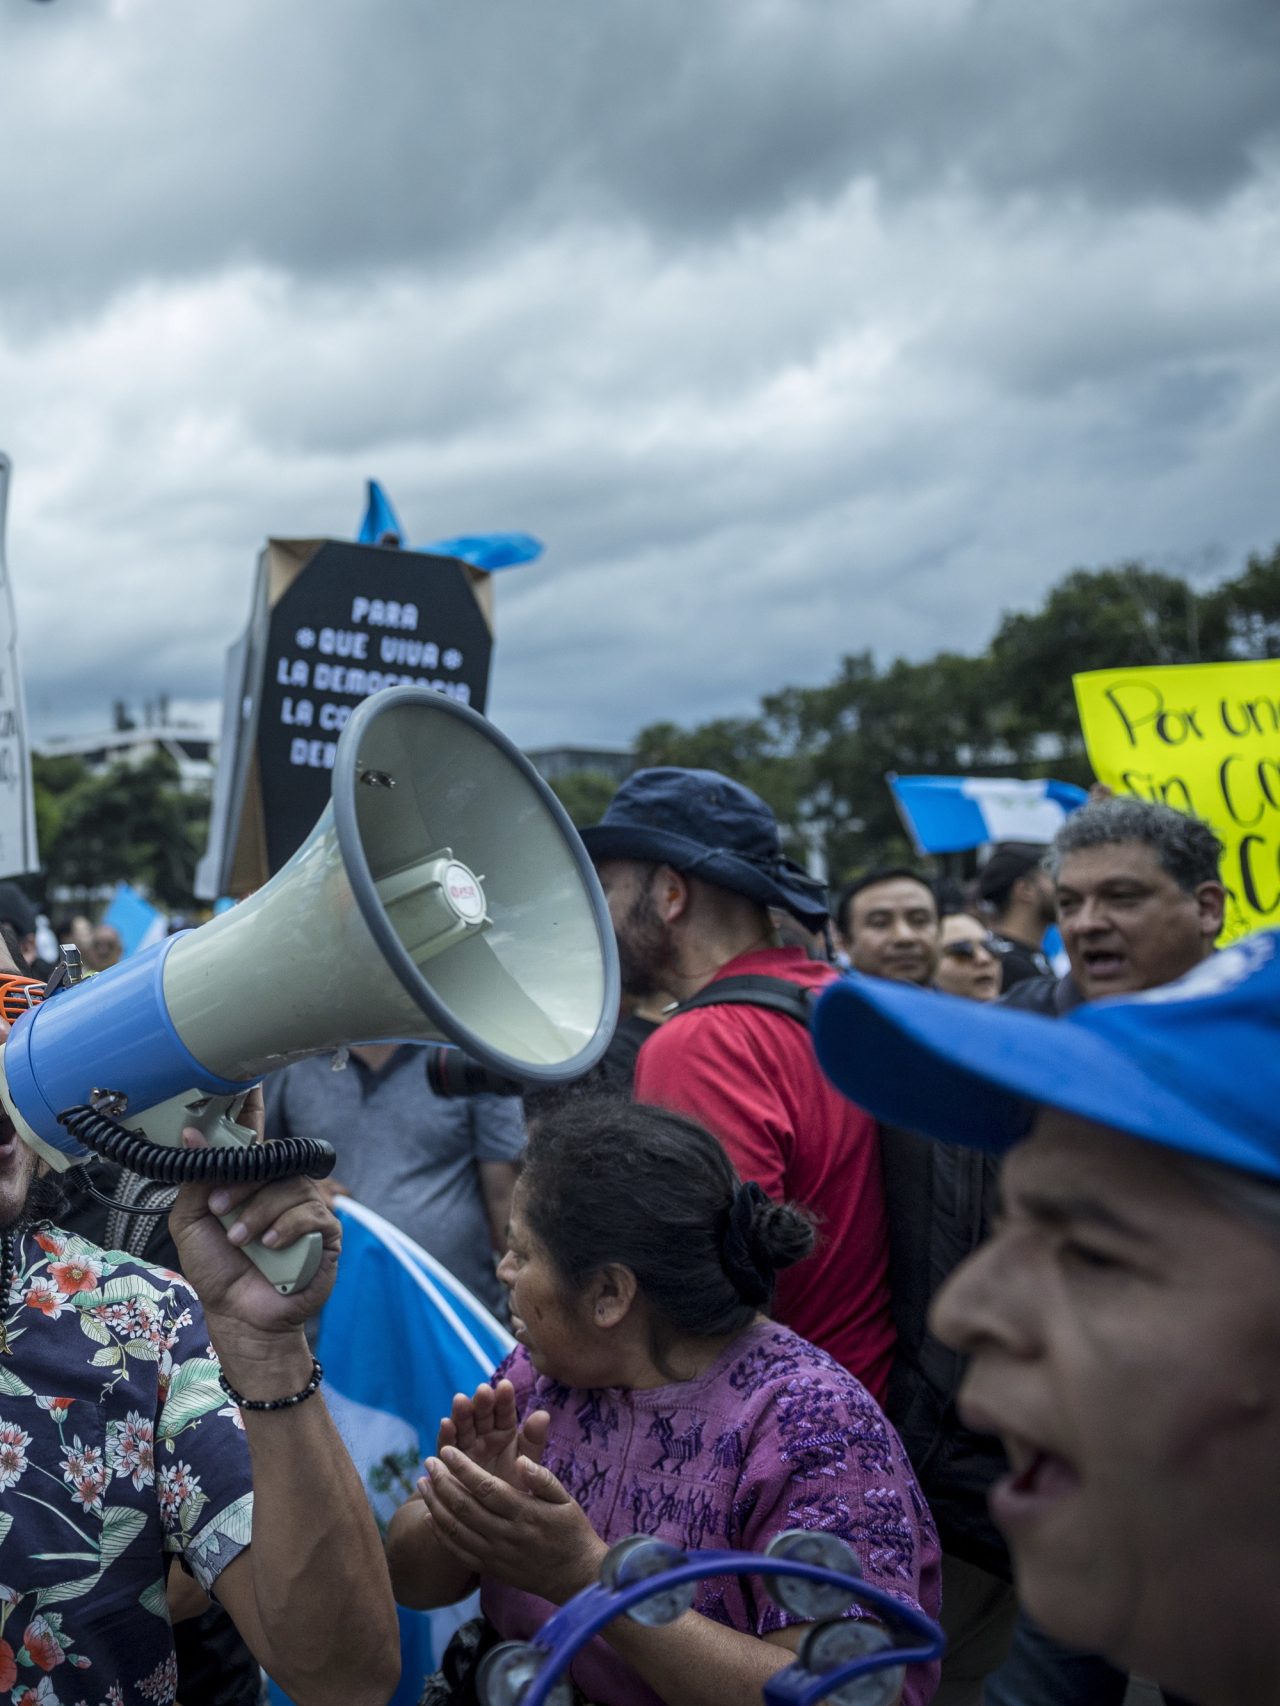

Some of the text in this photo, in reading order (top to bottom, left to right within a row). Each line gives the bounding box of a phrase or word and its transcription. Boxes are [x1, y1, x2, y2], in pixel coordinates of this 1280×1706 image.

[351, 596, 419, 631] PARA
[318, 627, 440, 670] QUE VIVA
[276, 656, 310, 688] LA
[280, 696, 315, 728] LA
[1104, 678, 1205, 748] Por
